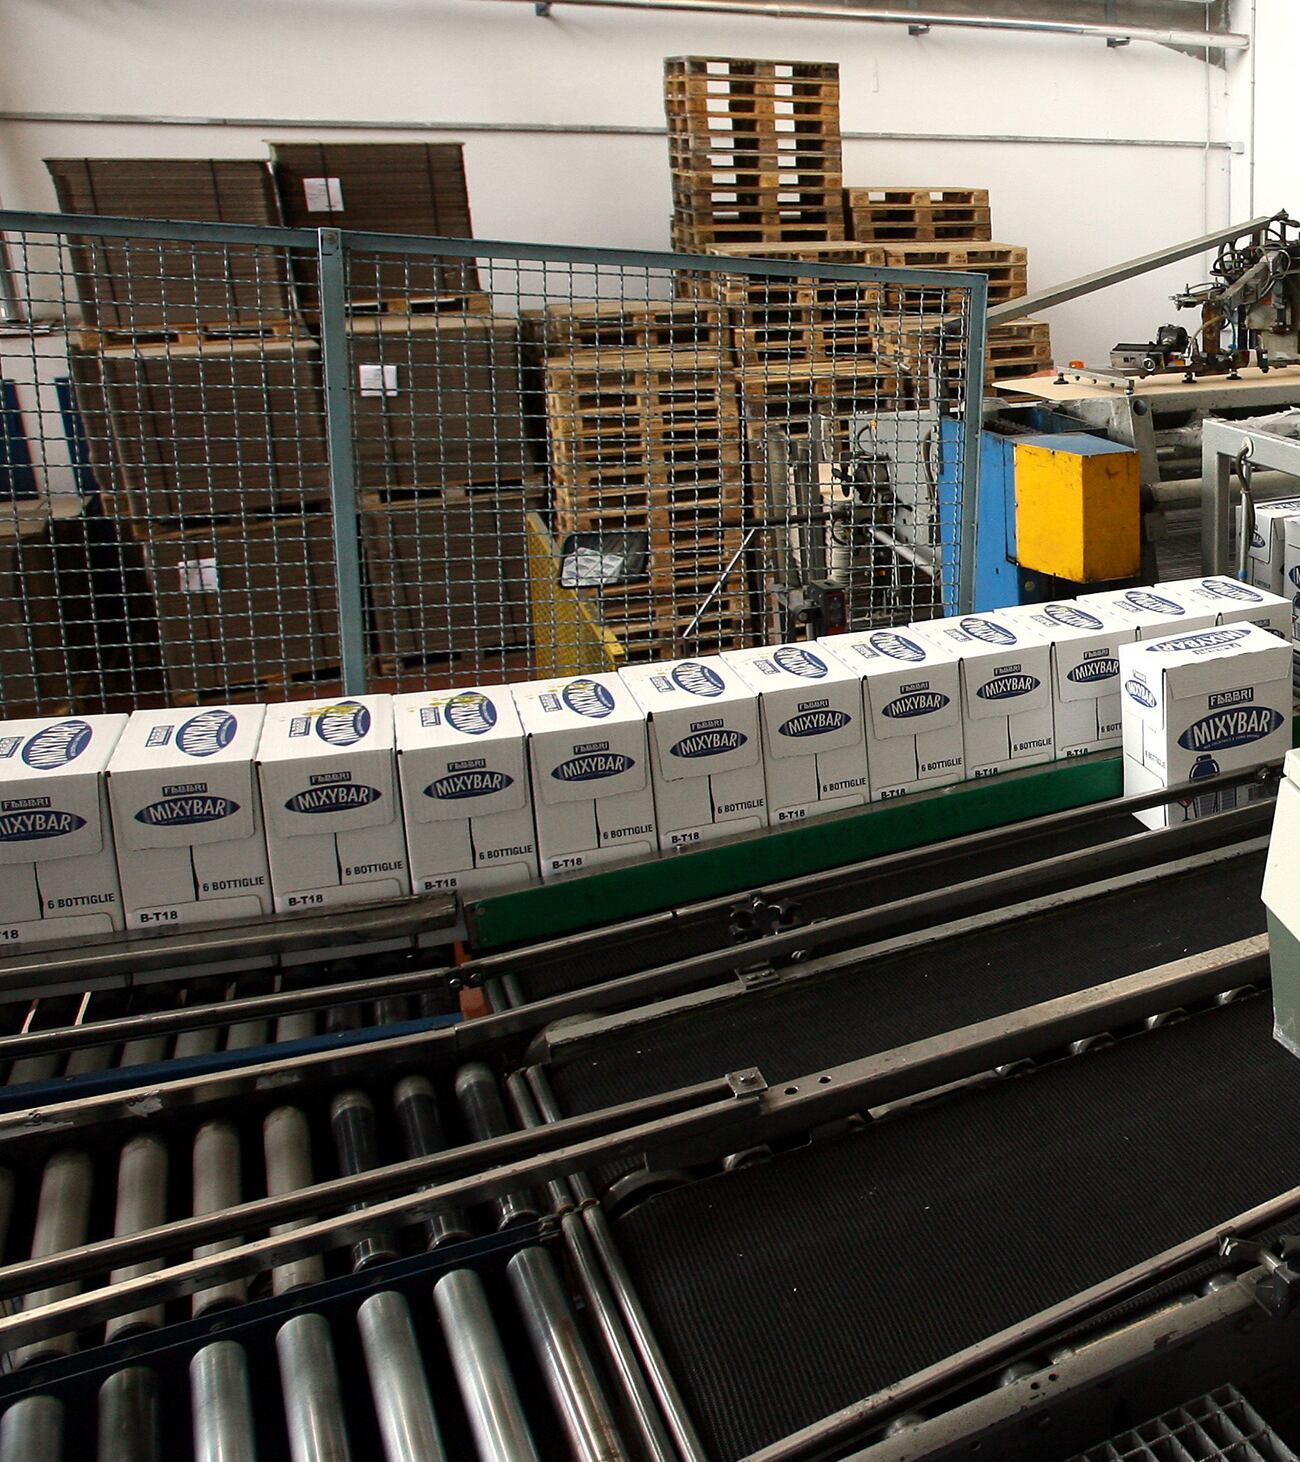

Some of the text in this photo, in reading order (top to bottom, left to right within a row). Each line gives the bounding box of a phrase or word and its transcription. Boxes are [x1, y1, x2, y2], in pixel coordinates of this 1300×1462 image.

[1075, 661, 1119, 681] MIXYBAR
[985, 677, 1032, 698] MIXYBAR
[891, 694, 941, 716] MIXYBAR
[1210, 689, 1252, 706] FABBRI
[787, 712, 843, 735] MIXYBAR
[1193, 710, 1271, 747] MIXYBAR
[680, 732, 738, 756] MIXYBAR
[1019, 738, 1052, 751] BOTTIGLIE
[562, 756, 624, 779] MIXYBAR
[927, 757, 962, 771] BOTTIGLIE
[436, 773, 502, 797] MIXYBAR
[829, 778, 867, 791] BOTTIGLIE
[297, 787, 369, 811] MIXYBAR
[717, 799, 764, 814] 6 BOTTIGLIE
[149, 799, 226, 822] MIXYBAR
[778, 809, 806, 821] B-T18
[603, 824, 653, 840] 6 BOTTIGLIE
[671, 832, 700, 844] B-T18
[479, 845, 533, 860] 6 BOTTIGLIE
[345, 860, 404, 876] 6 BOTTIGLIE
[552, 857, 583, 869] B-T18
[203, 876, 265, 892] 6 BOTTIGLIE
[424, 878, 457, 890] B-T18
[47, 893, 115, 910] 6 BOTTIGLIE
[288, 894, 324, 907] B-T18
[140, 910, 178, 923] B-T18
